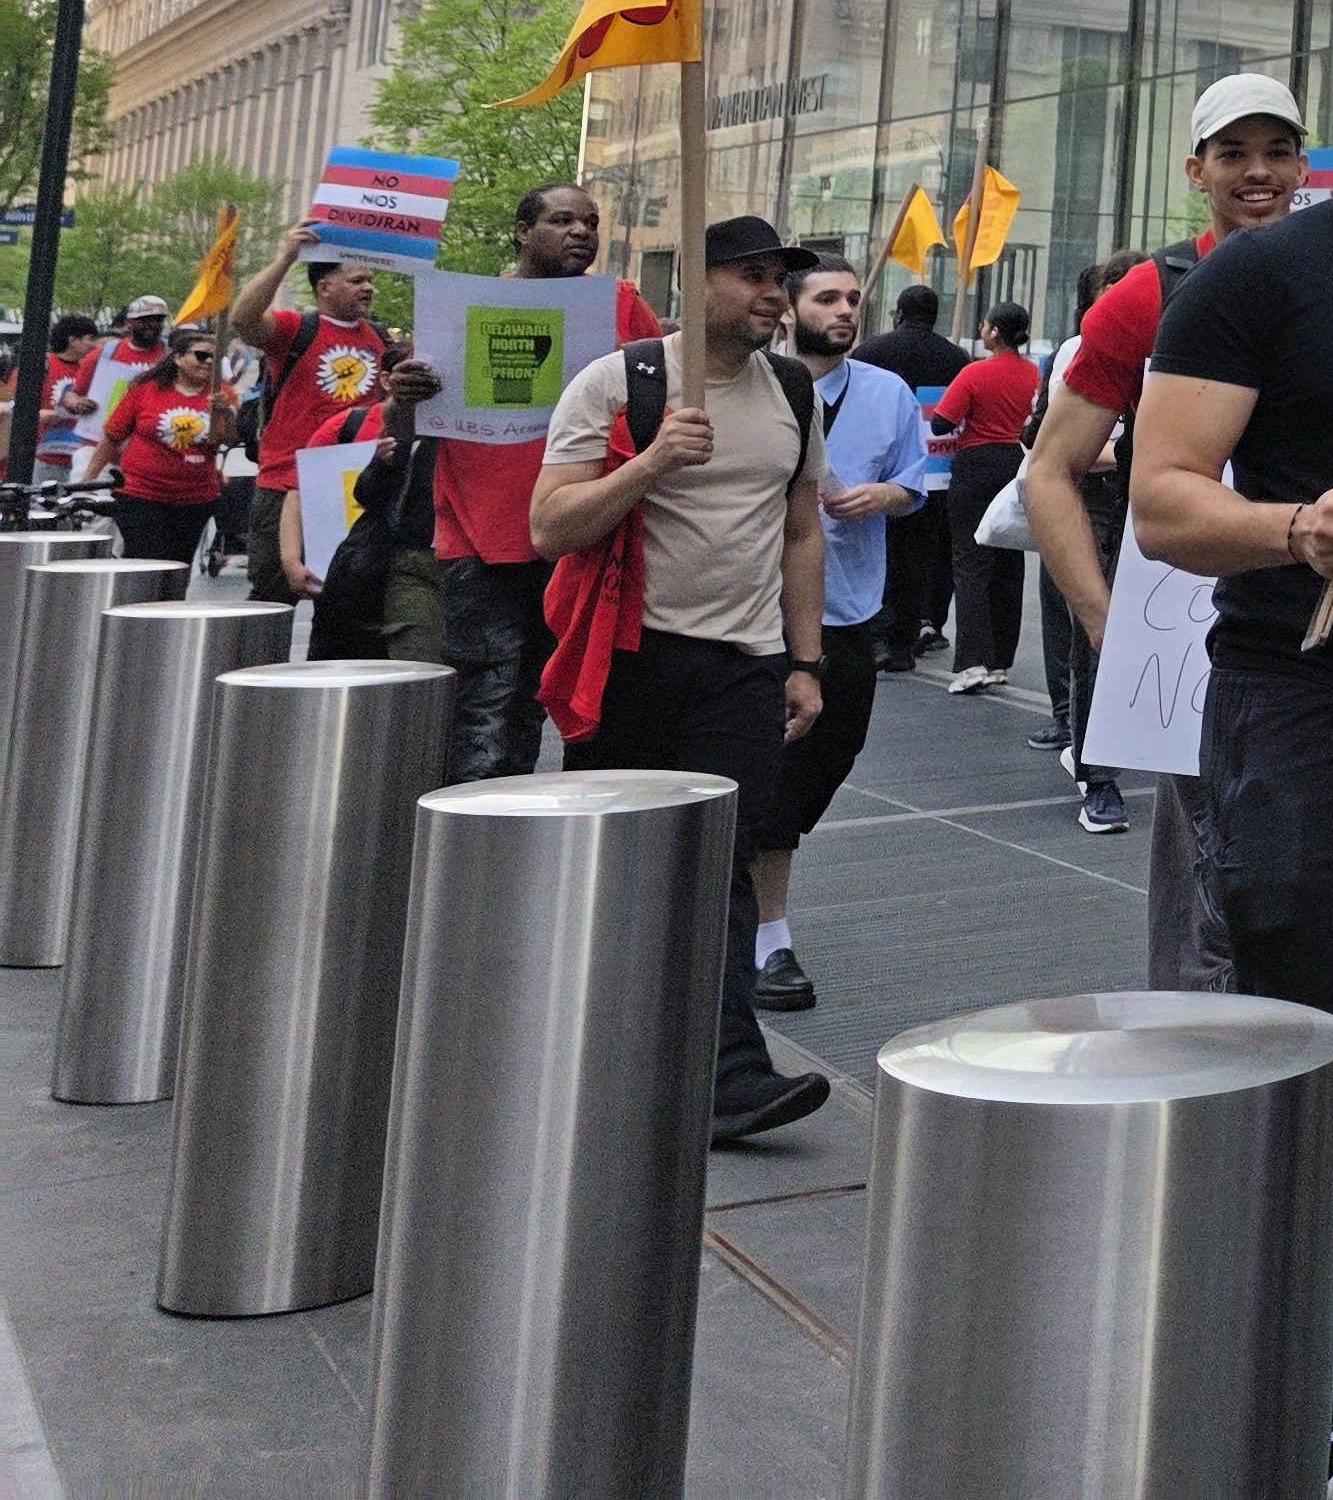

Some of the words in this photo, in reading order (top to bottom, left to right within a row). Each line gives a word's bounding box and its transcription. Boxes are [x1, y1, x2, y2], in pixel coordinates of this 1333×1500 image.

[372, 174, 399, 189] NO
[361, 193, 399, 210] NOS
[327, 208, 421, 233] DIVIDIRAN
